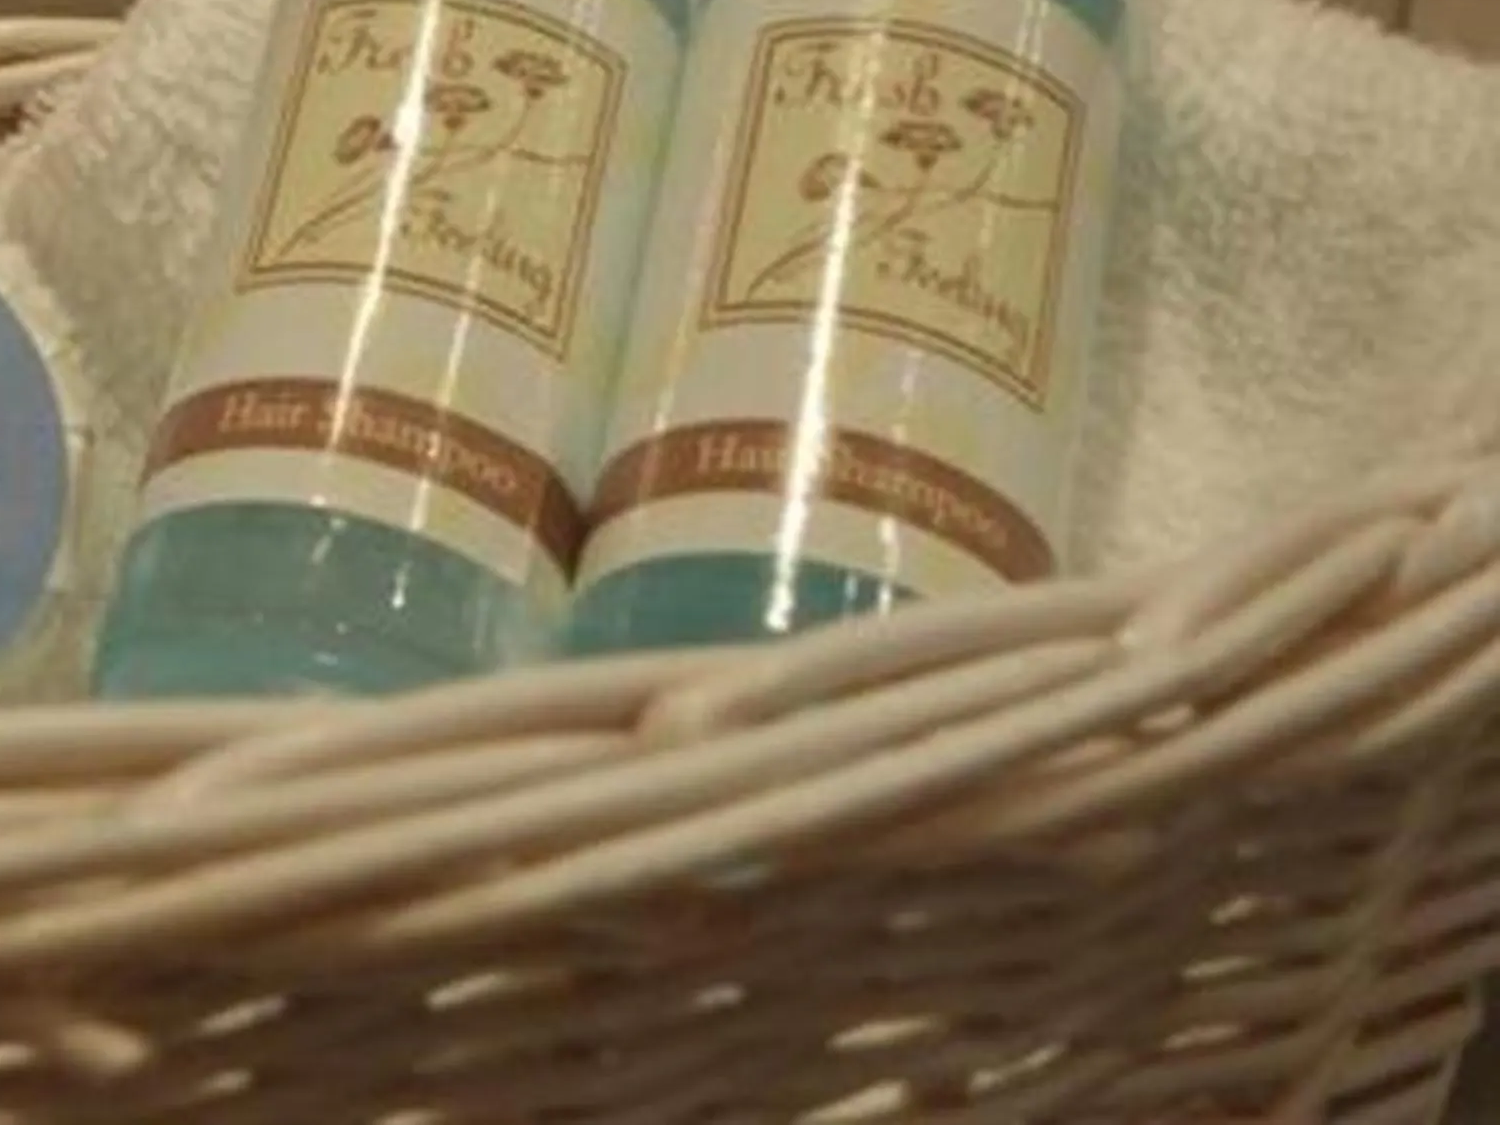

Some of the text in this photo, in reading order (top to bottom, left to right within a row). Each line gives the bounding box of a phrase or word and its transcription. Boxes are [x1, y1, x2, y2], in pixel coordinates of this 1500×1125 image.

[316, 6, 476, 78] Freh
[217, 389, 311, 433] Hair
[697, 430, 1008, 549] Hai hampoo
